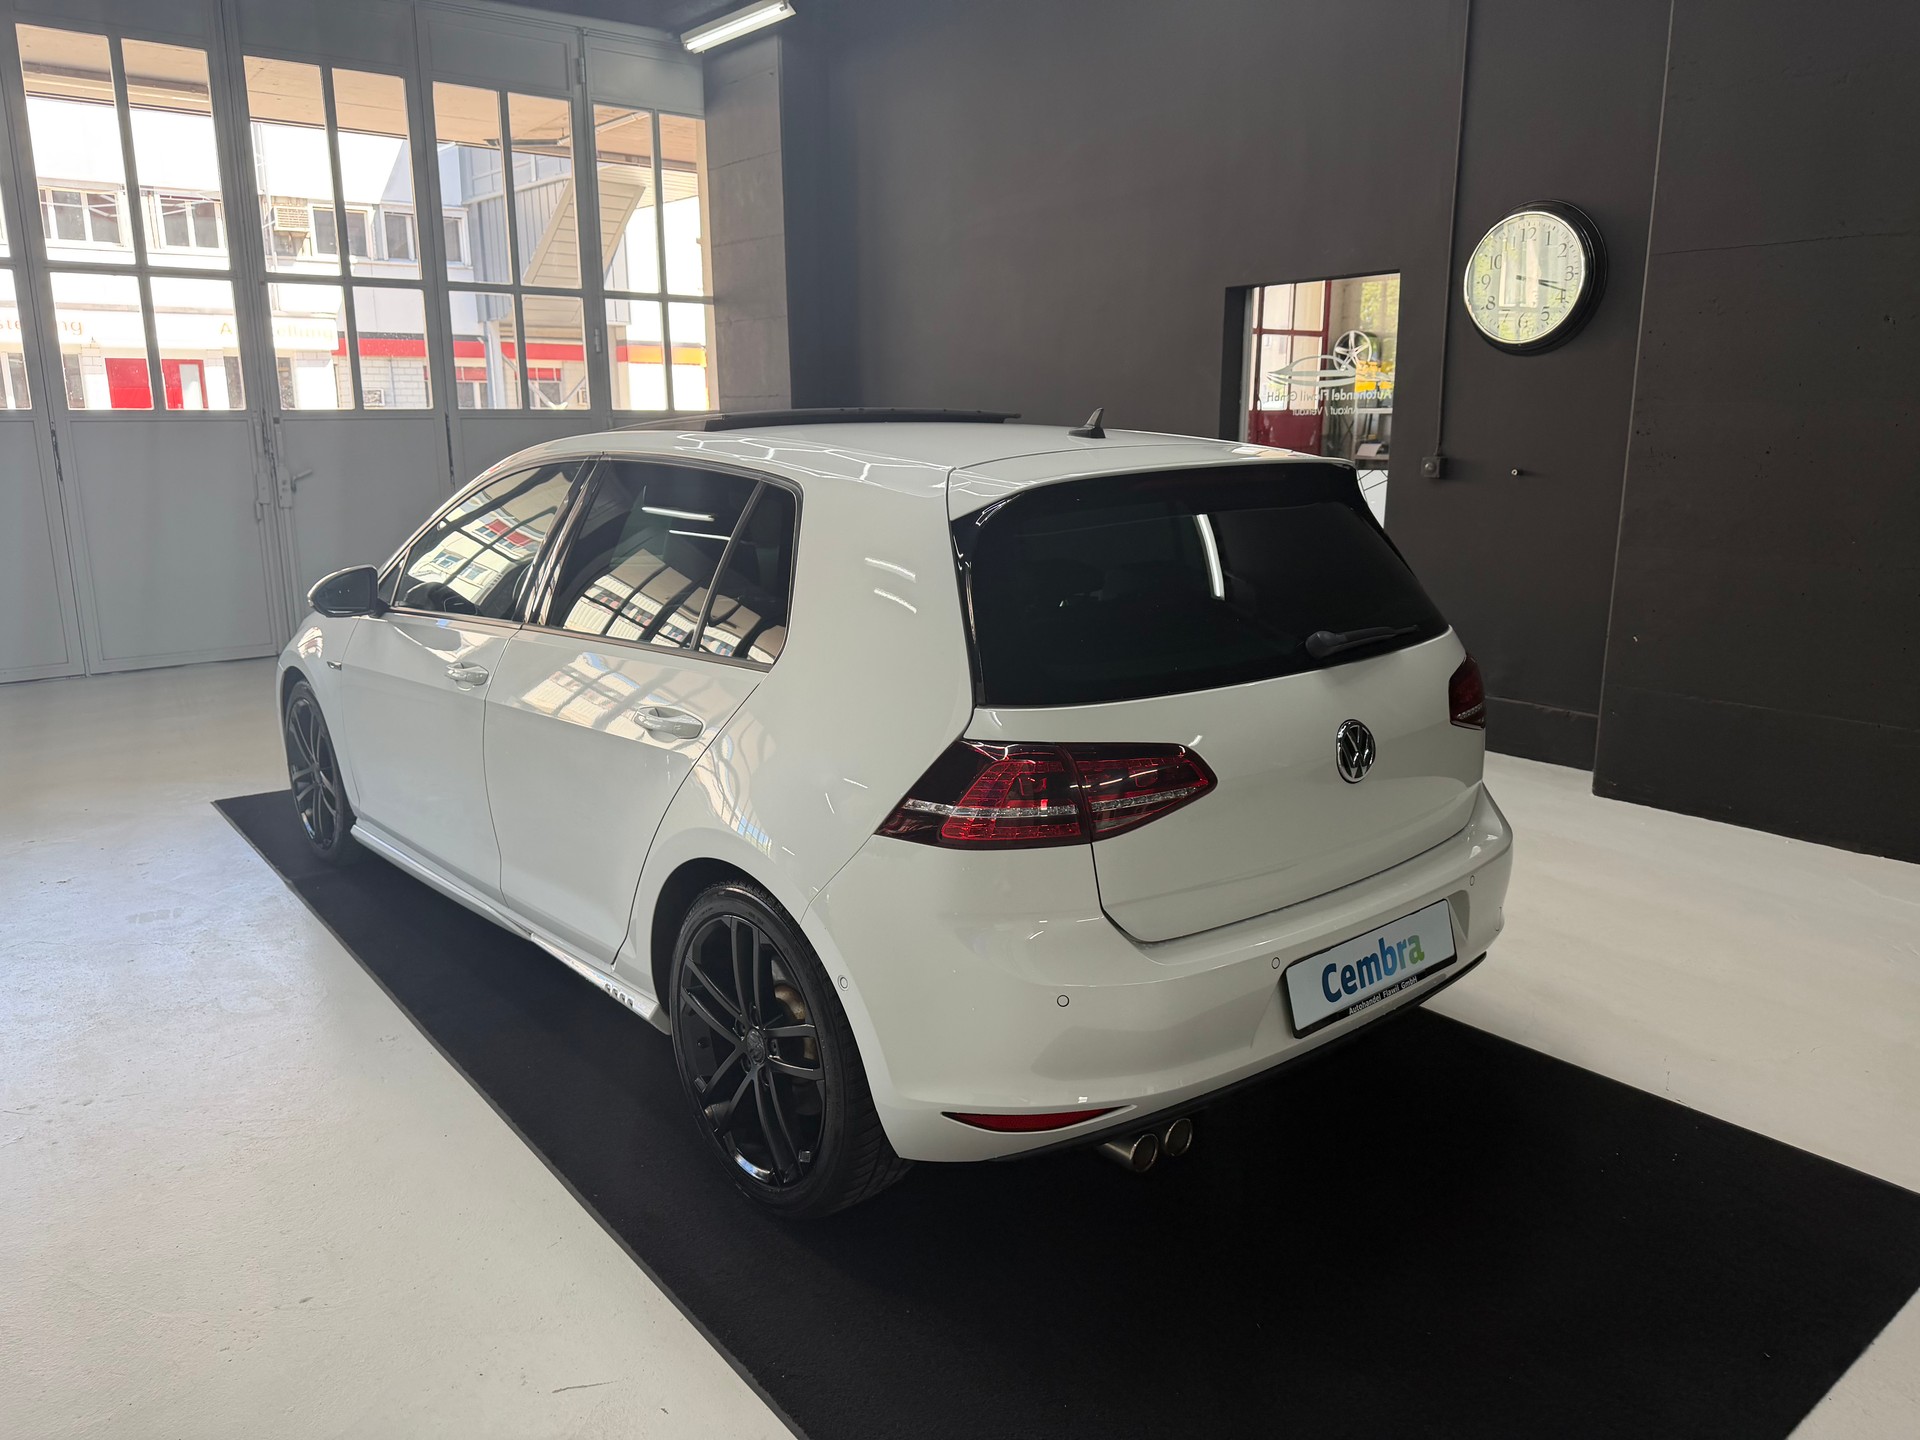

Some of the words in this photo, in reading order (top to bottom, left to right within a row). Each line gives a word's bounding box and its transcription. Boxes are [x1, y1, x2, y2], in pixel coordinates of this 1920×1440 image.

[1521, 227, 1537, 243] 12
[1545, 231, 1552, 246] 1
[1557, 243, 1567, 258] 2
[1489, 254, 1503, 271] 10
[1564, 266, 1574, 281] 3
[1481, 274, 1491, 290] 9
[1486, 296, 1496, 310] 8
[1555, 290, 1566, 303] 4
[1501, 309, 1511, 323] 7
[1517, 313, 1528, 328] 6
[1540, 306, 1550, 321] 5
[1336, 719, 1376, 784] VW
[1321, 934, 1425, 1003] Cembra
[1349, 994, 1381, 1015] Autohandel
[1383, 986, 1399, 998] Flawil
[1401, 976, 1418, 989] GmbH
